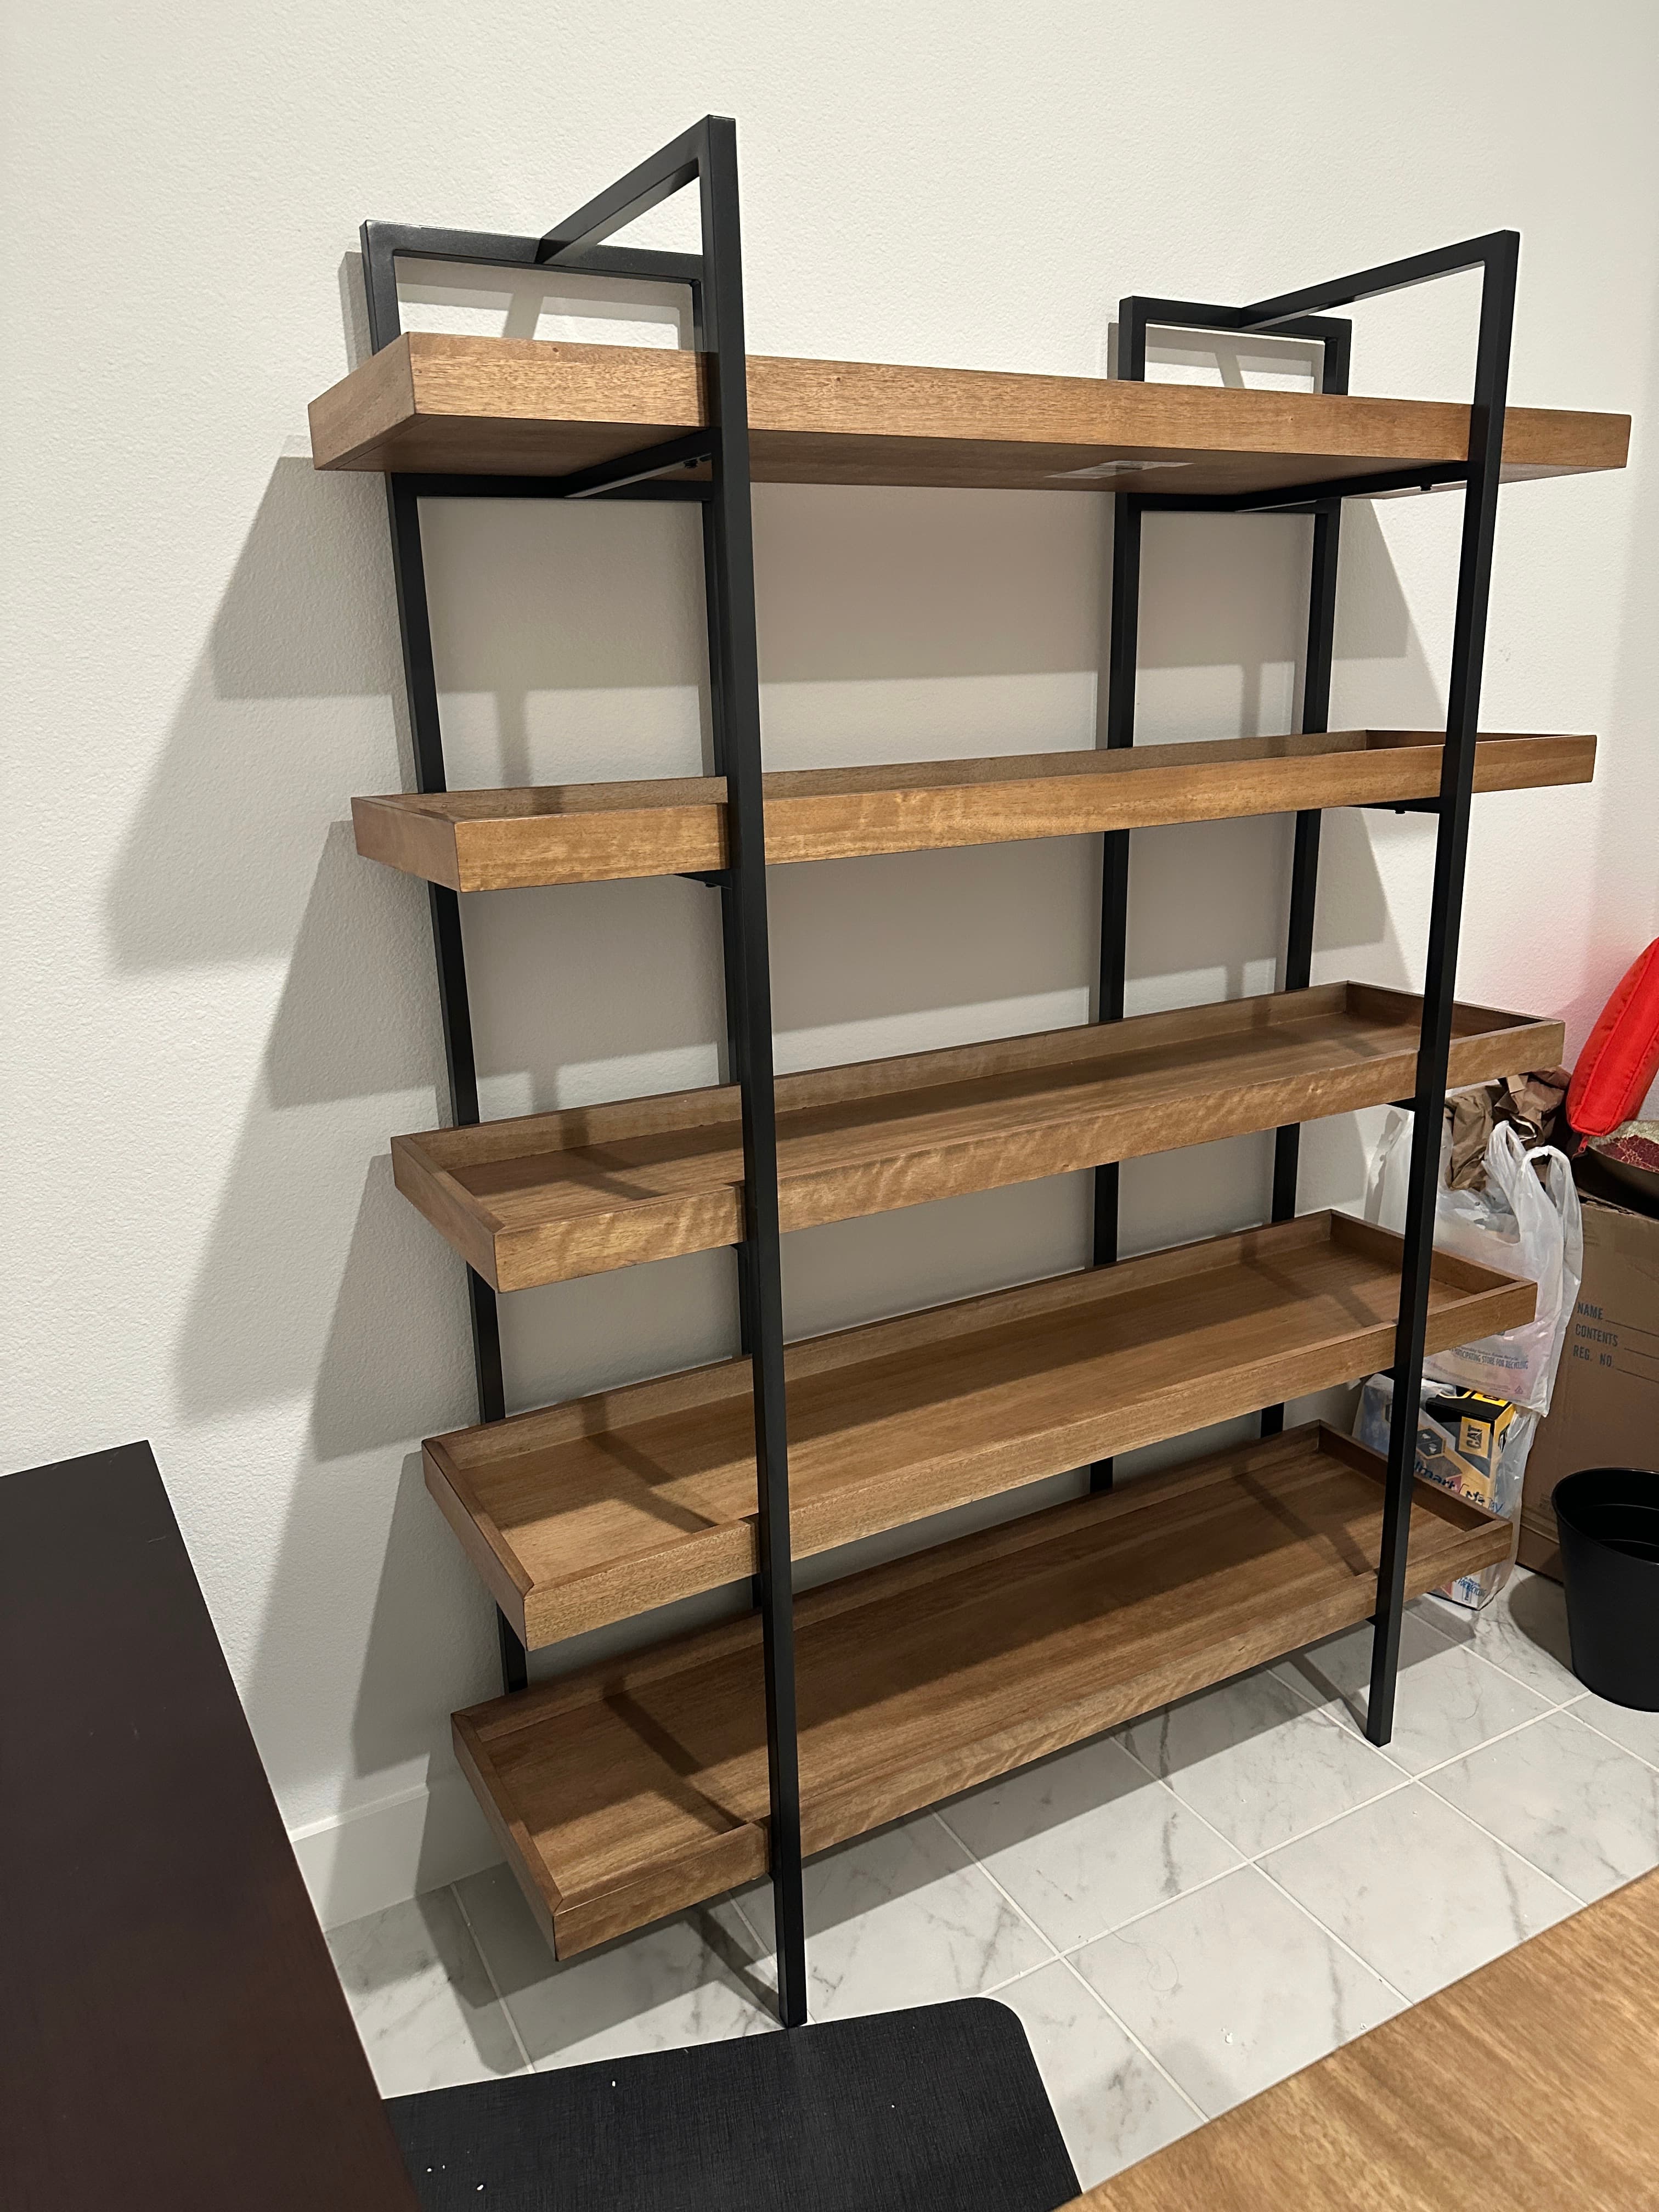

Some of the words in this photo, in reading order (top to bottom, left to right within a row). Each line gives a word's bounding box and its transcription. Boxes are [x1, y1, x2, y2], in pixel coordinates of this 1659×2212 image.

[1577, 1302, 1604, 1320] NAME
[1575, 1323, 1618, 1347] CONTENTS
[1496, 1358, 1504, 1367] FOR
[1466, 1425, 1483, 1449] CAT
